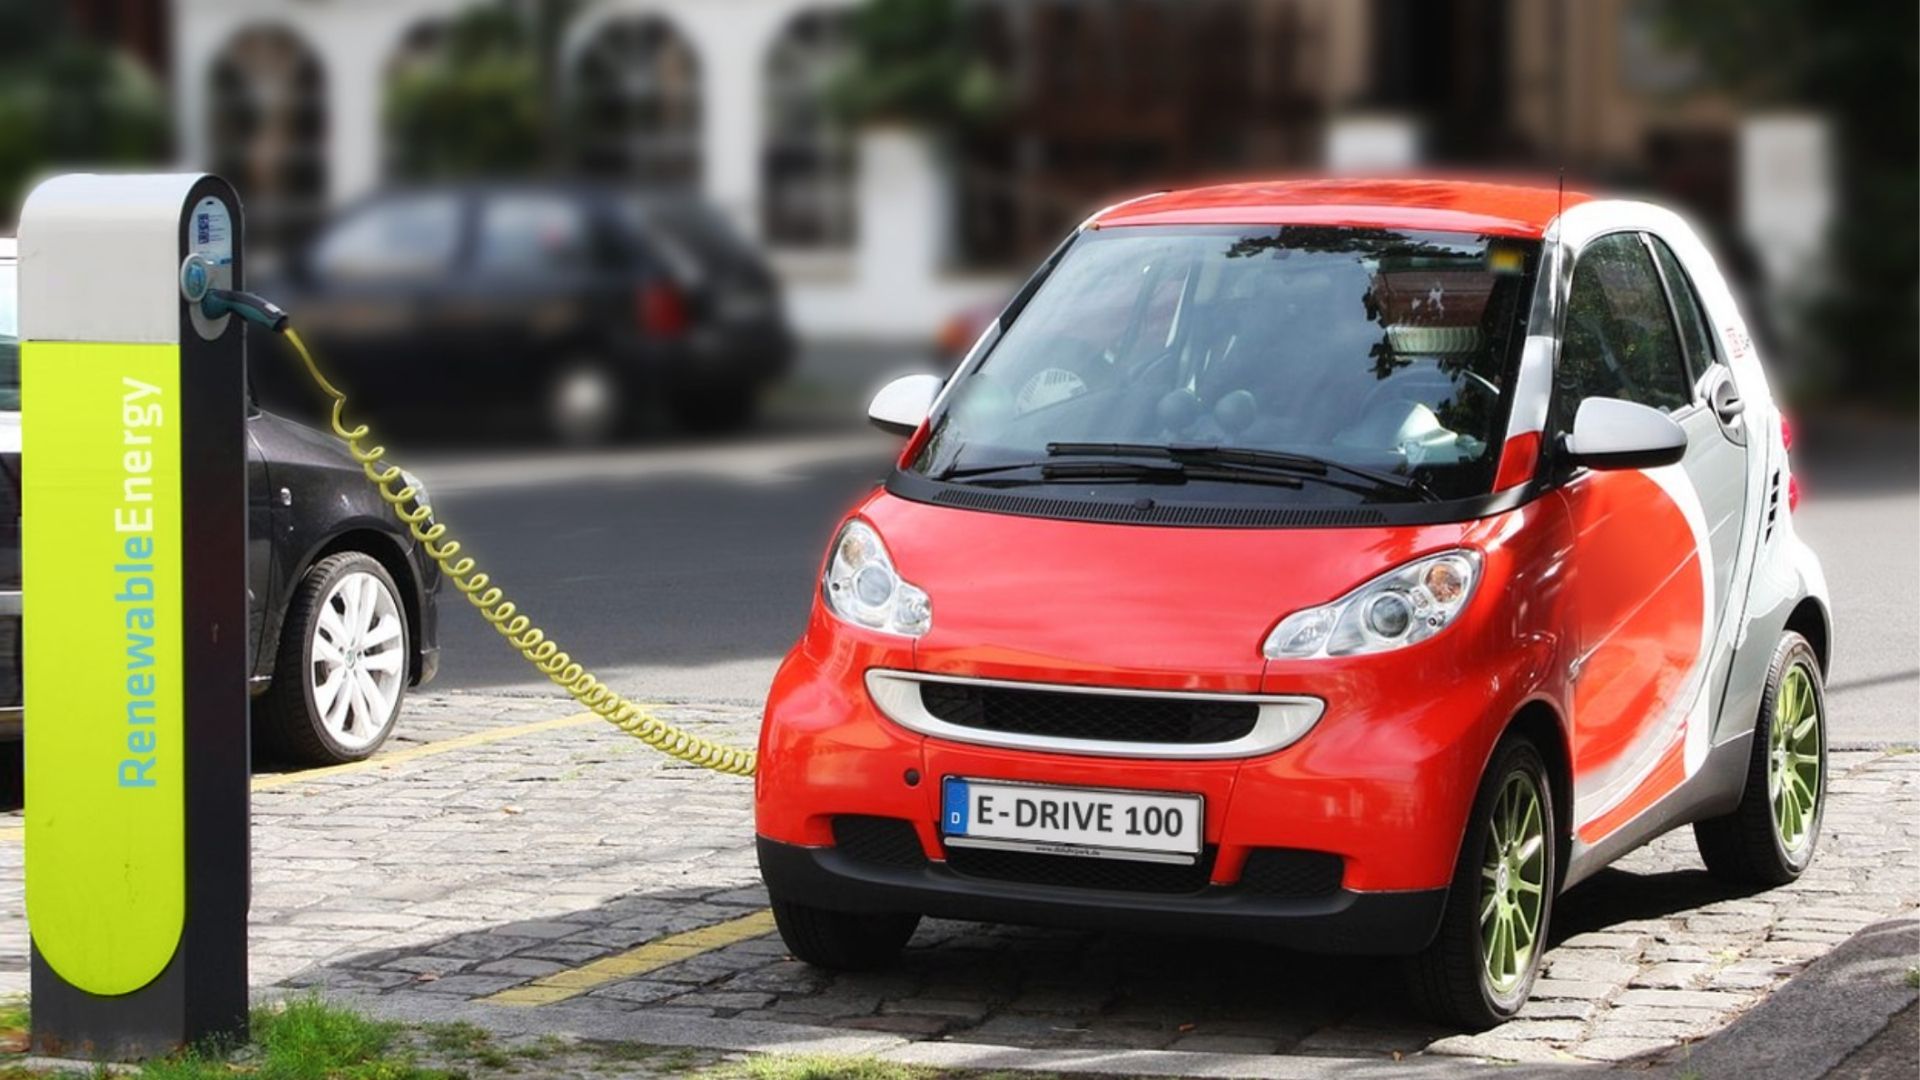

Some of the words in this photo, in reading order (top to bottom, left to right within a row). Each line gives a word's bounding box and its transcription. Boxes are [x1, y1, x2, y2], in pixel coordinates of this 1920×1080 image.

[114, 376, 163, 788] RenewableEnergy
[951, 811, 961, 824] D
[977, 795, 1113, 832] E-DRIVE
[1125, 806, 1183, 837] 100
